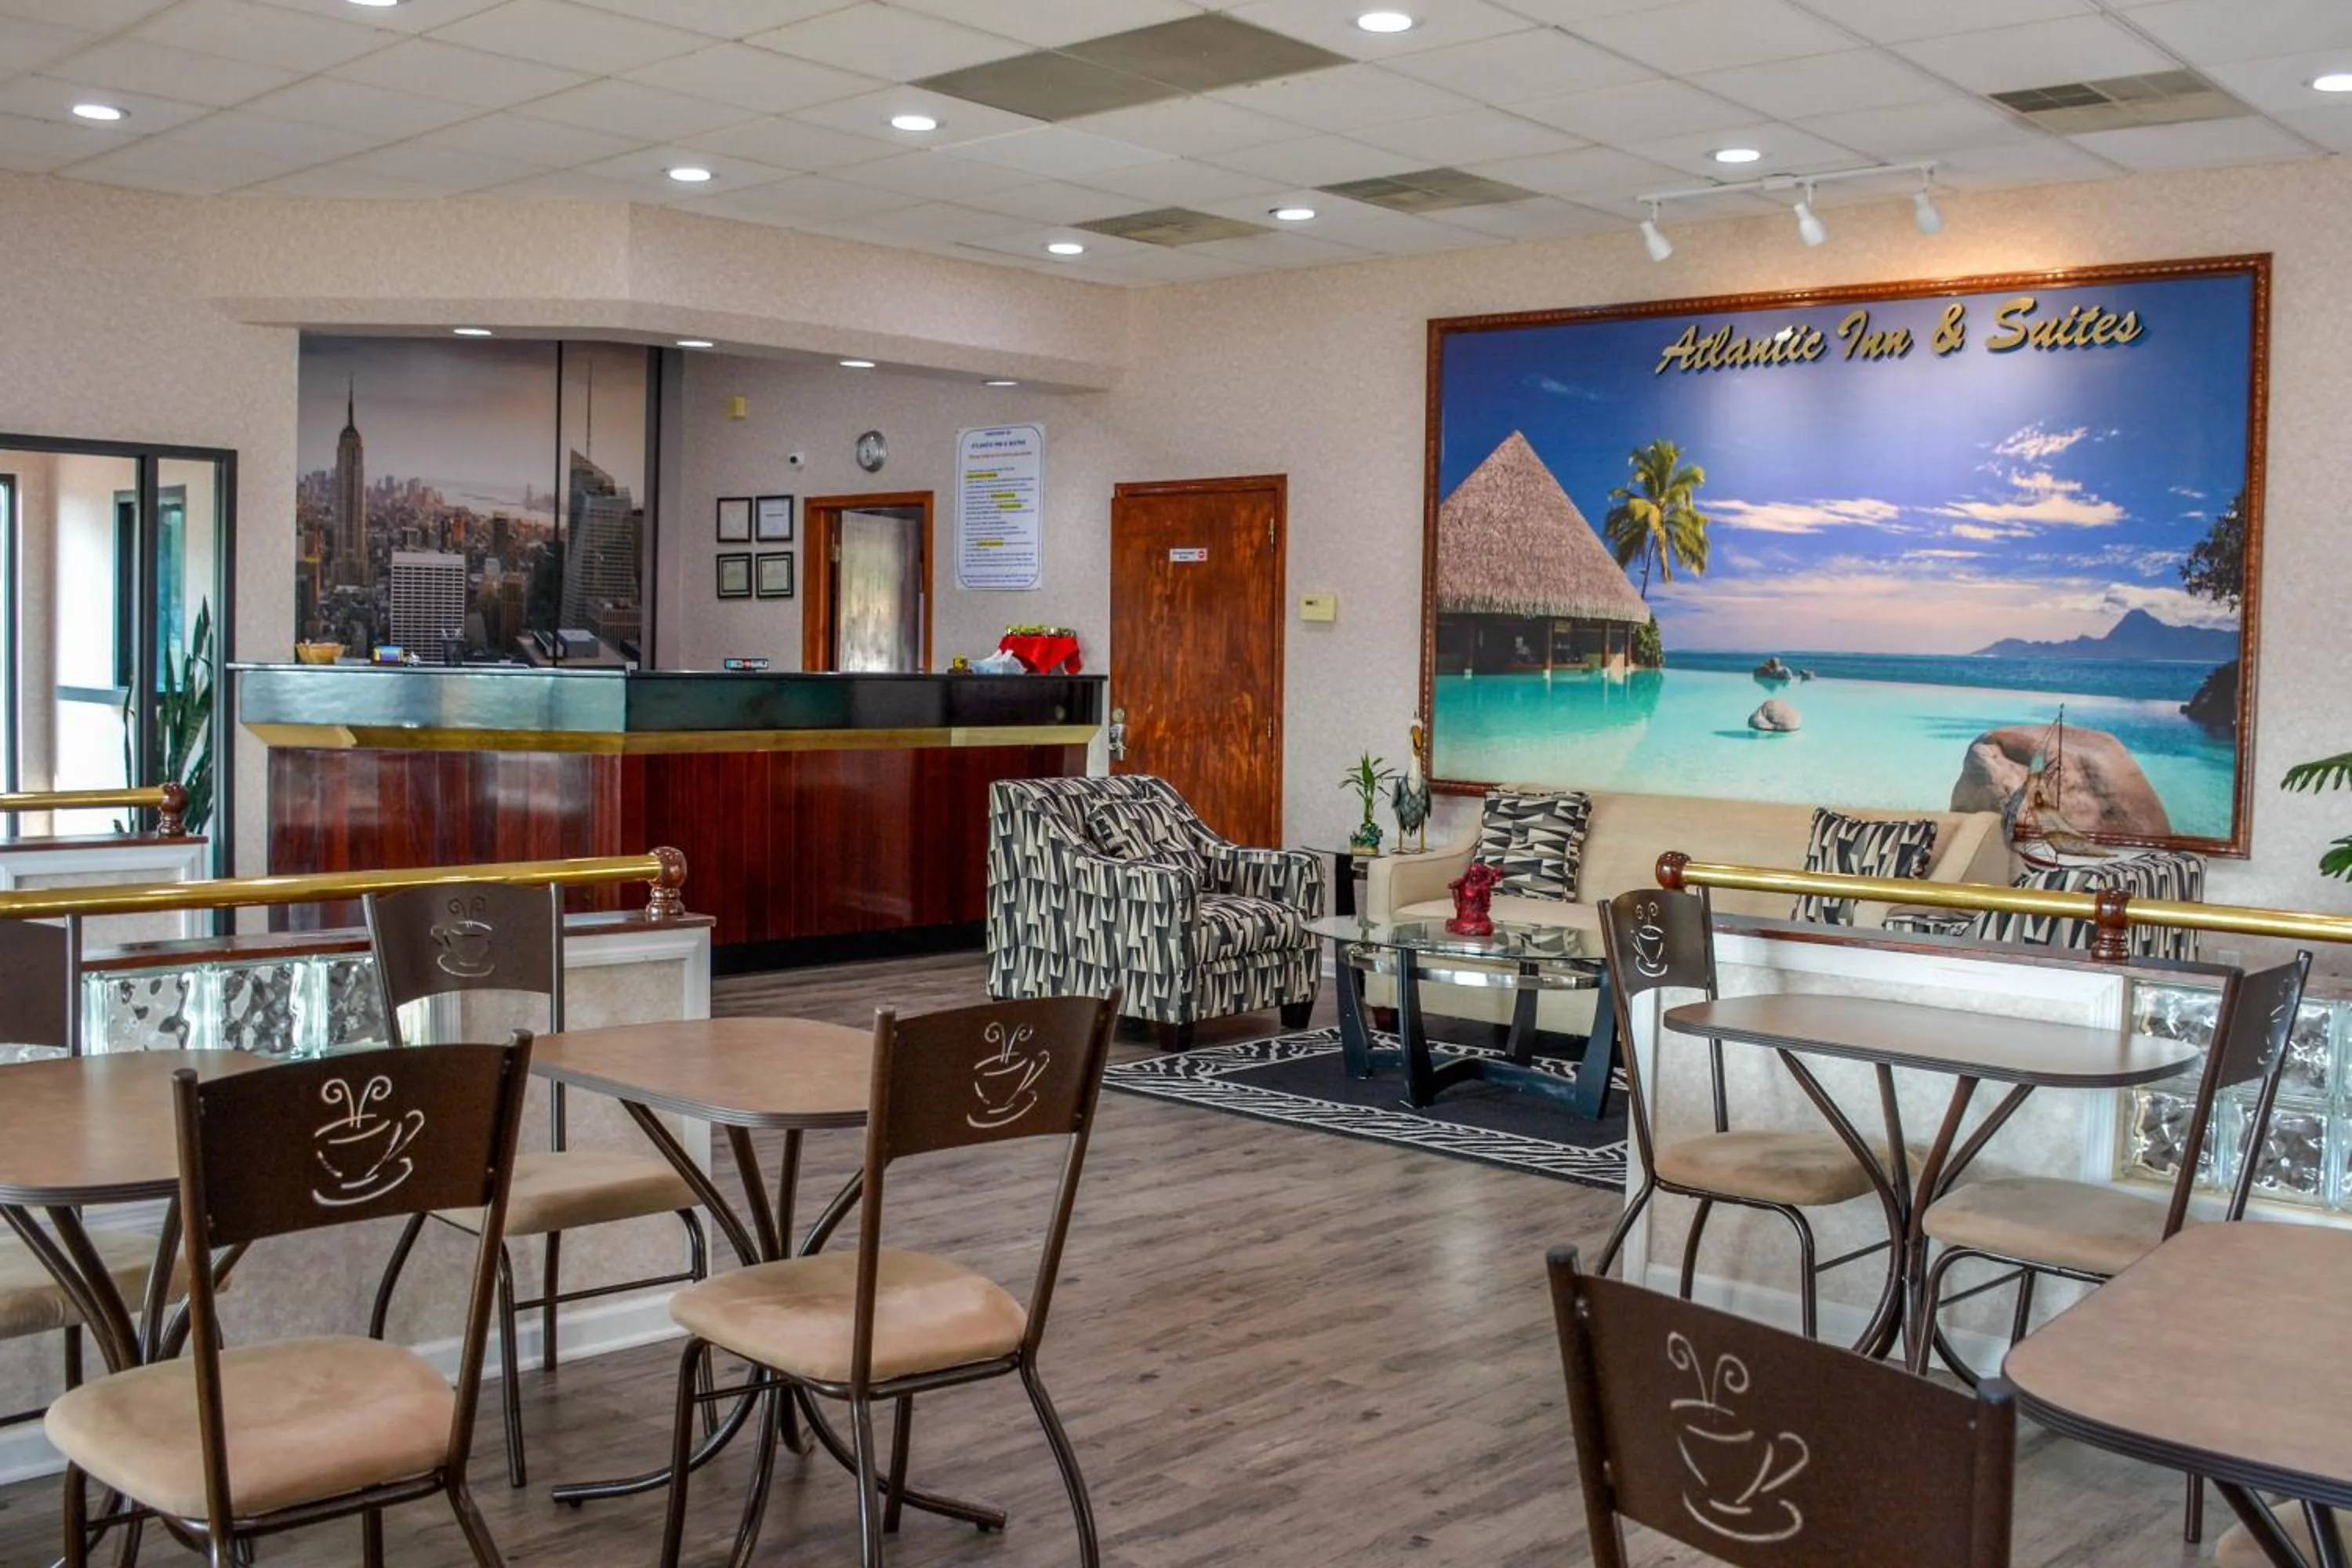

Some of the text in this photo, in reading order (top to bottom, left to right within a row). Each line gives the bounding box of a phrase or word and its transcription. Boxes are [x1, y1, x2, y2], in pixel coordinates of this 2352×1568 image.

[1655, 297, 2147, 375] Atlantic Inn & Suites
